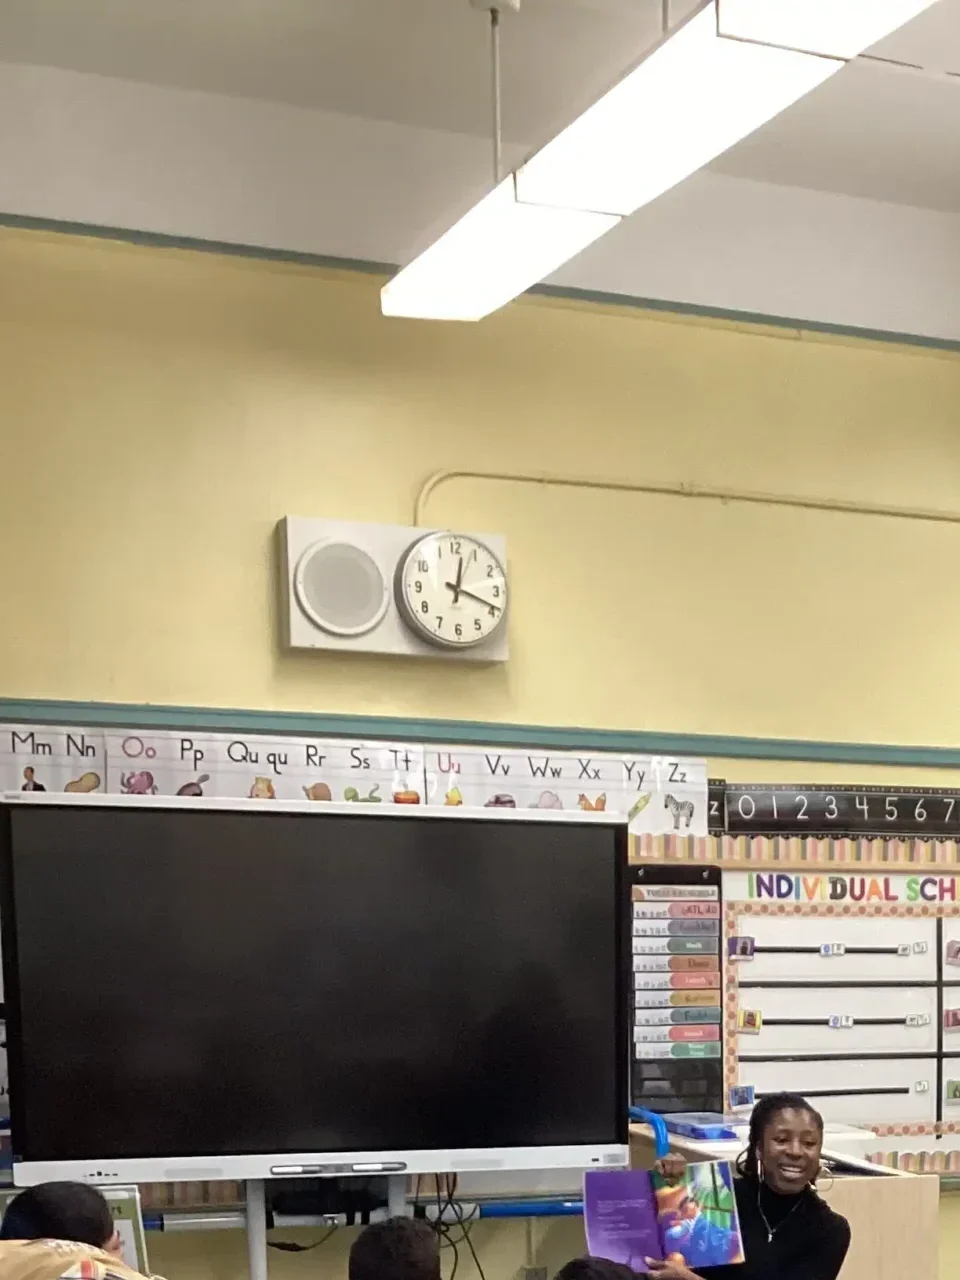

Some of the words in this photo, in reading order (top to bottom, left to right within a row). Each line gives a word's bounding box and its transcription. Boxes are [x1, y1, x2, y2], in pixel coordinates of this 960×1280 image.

[450, 541, 461, 554] 12
[418, 560, 428, 573] 10
[486, 565, 494, 578] 2
[414, 580, 422, 593] 9
[492, 585, 500, 598] 3
[421, 600, 428, 614] 8
[488, 605, 496, 618] 4
[436, 616, 443, 629] 7
[474, 619, 482, 631] 5
[455, 624, 462, 636] 6
[11, 731, 52, 756] Mm
[66, 733, 96, 757] Nn
[122, 736, 156, 758] Oo
[180, 738, 204, 771] Pp
[227, 740, 259, 764] Qu
[266, 751, 288, 775] qu
[305, 744, 326, 767] Rr
[350, 748, 370, 769] Ss
[389, 749, 412, 771] Tt
[437, 752, 461, 774] Uu
[485, 754, 510, 776] Vv
[528, 756, 562, 778] Ww
[578, 758, 601, 780] Xx
[623, 760, 646, 790] Yy
[668, 763, 686, 783] Zz
[738, 794, 756, 818] 0
[772, 795, 778, 819] 1
[796, 796, 809, 820] 2
[824, 796, 838, 820] 3
[854, 796, 868, 820] 4
[884, 796, 898, 820] 5
[914, 798, 928, 820] 6
[943, 798, 956, 821] 7
[748, 872, 898, 900] INDIVIDUAL
